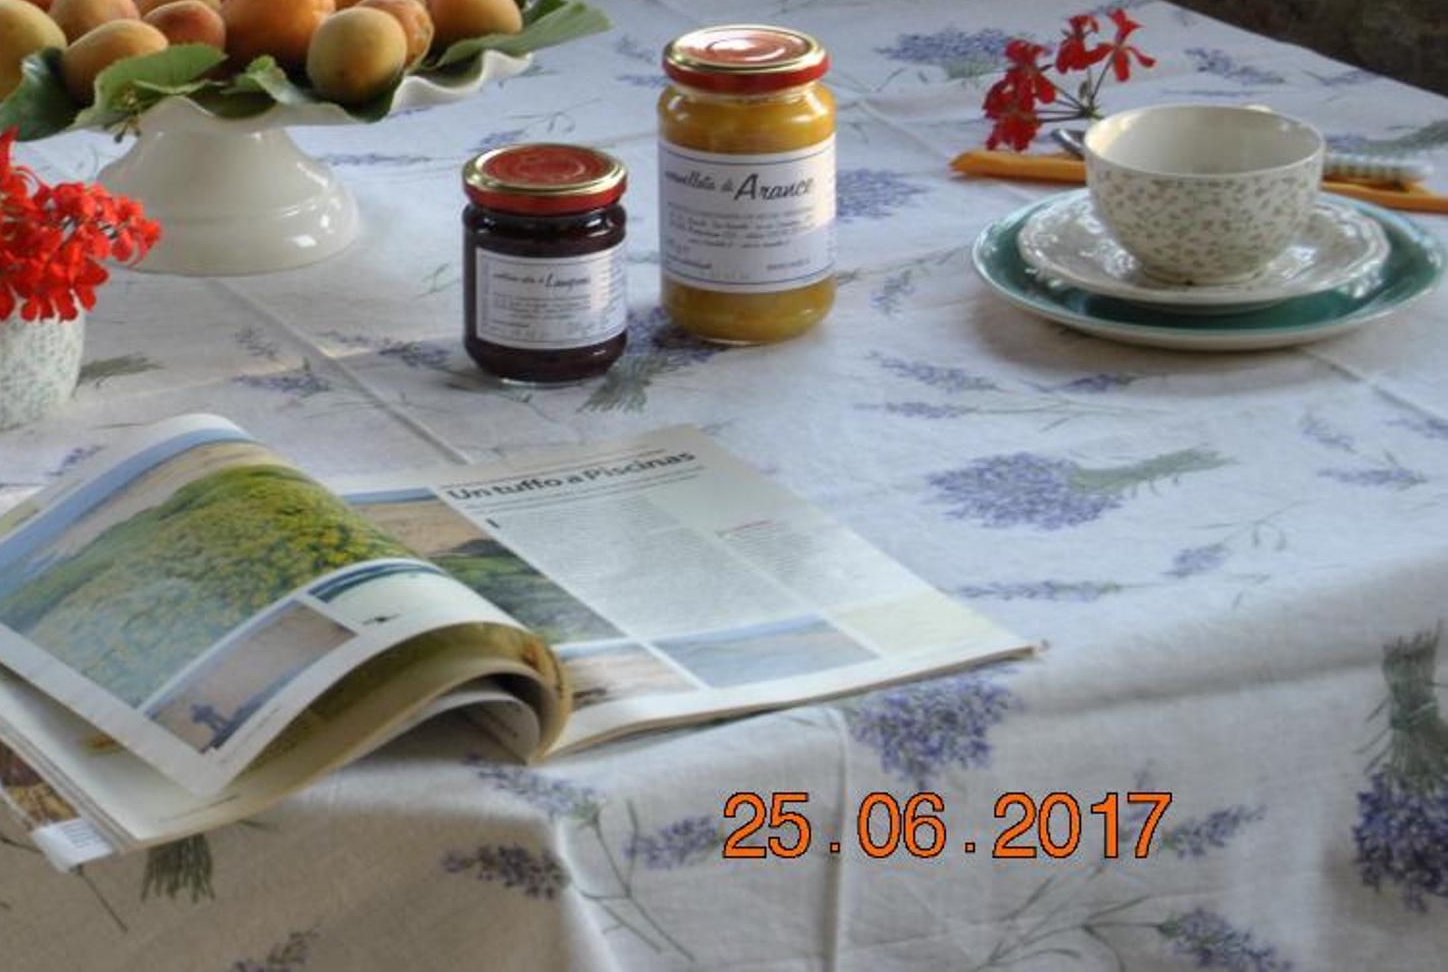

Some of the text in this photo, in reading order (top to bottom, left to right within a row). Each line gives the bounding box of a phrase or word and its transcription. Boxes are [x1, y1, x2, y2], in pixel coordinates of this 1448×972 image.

[734, 173, 815, 201] Arance
[447, 487, 492, 501] Un
[493, 477, 563, 495] tuffo
[565, 475, 584, 485] a
[583, 450, 696, 481] Piscinas
